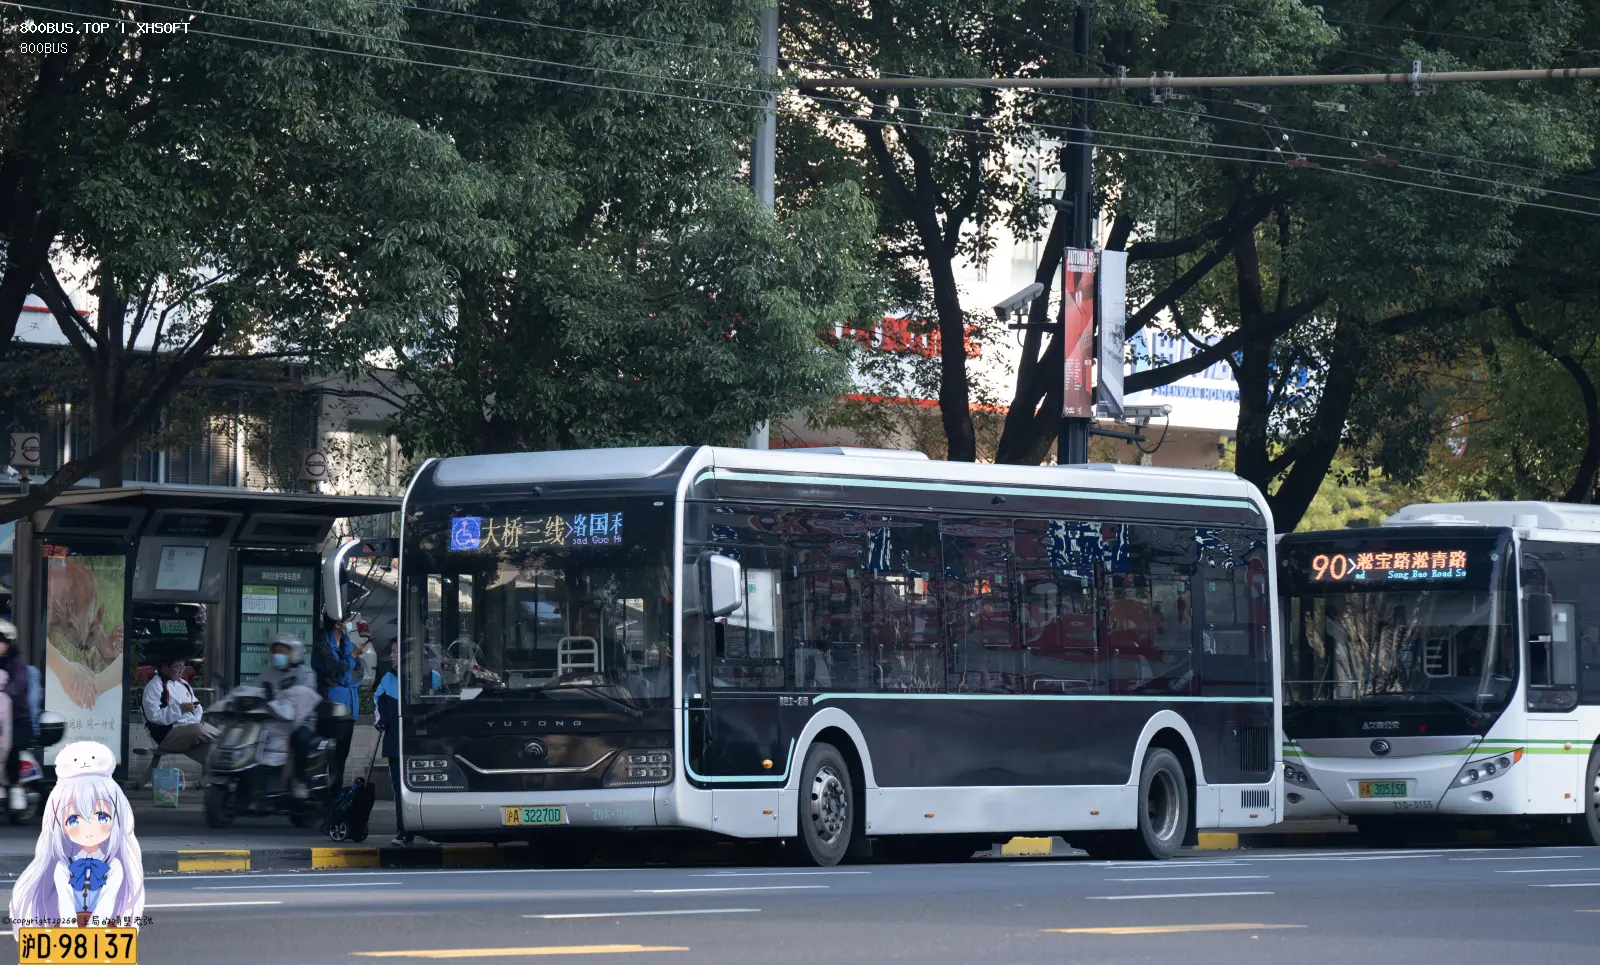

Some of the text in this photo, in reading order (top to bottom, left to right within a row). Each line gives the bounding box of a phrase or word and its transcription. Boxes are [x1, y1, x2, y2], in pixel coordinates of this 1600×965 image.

[481, 515, 565, 548] 大桥三线
[592, 535, 609, 544] Guo
[1312, 554, 1347, 580] 90
[1356, 550, 1467, 570] 淞宝路淞青路
[1388, 570, 1408, 580] Song
[1413, 569, 1427, 578] Bao
[1432, 568, 1452, 577] Road
[1456, 568, 1466, 577] So
